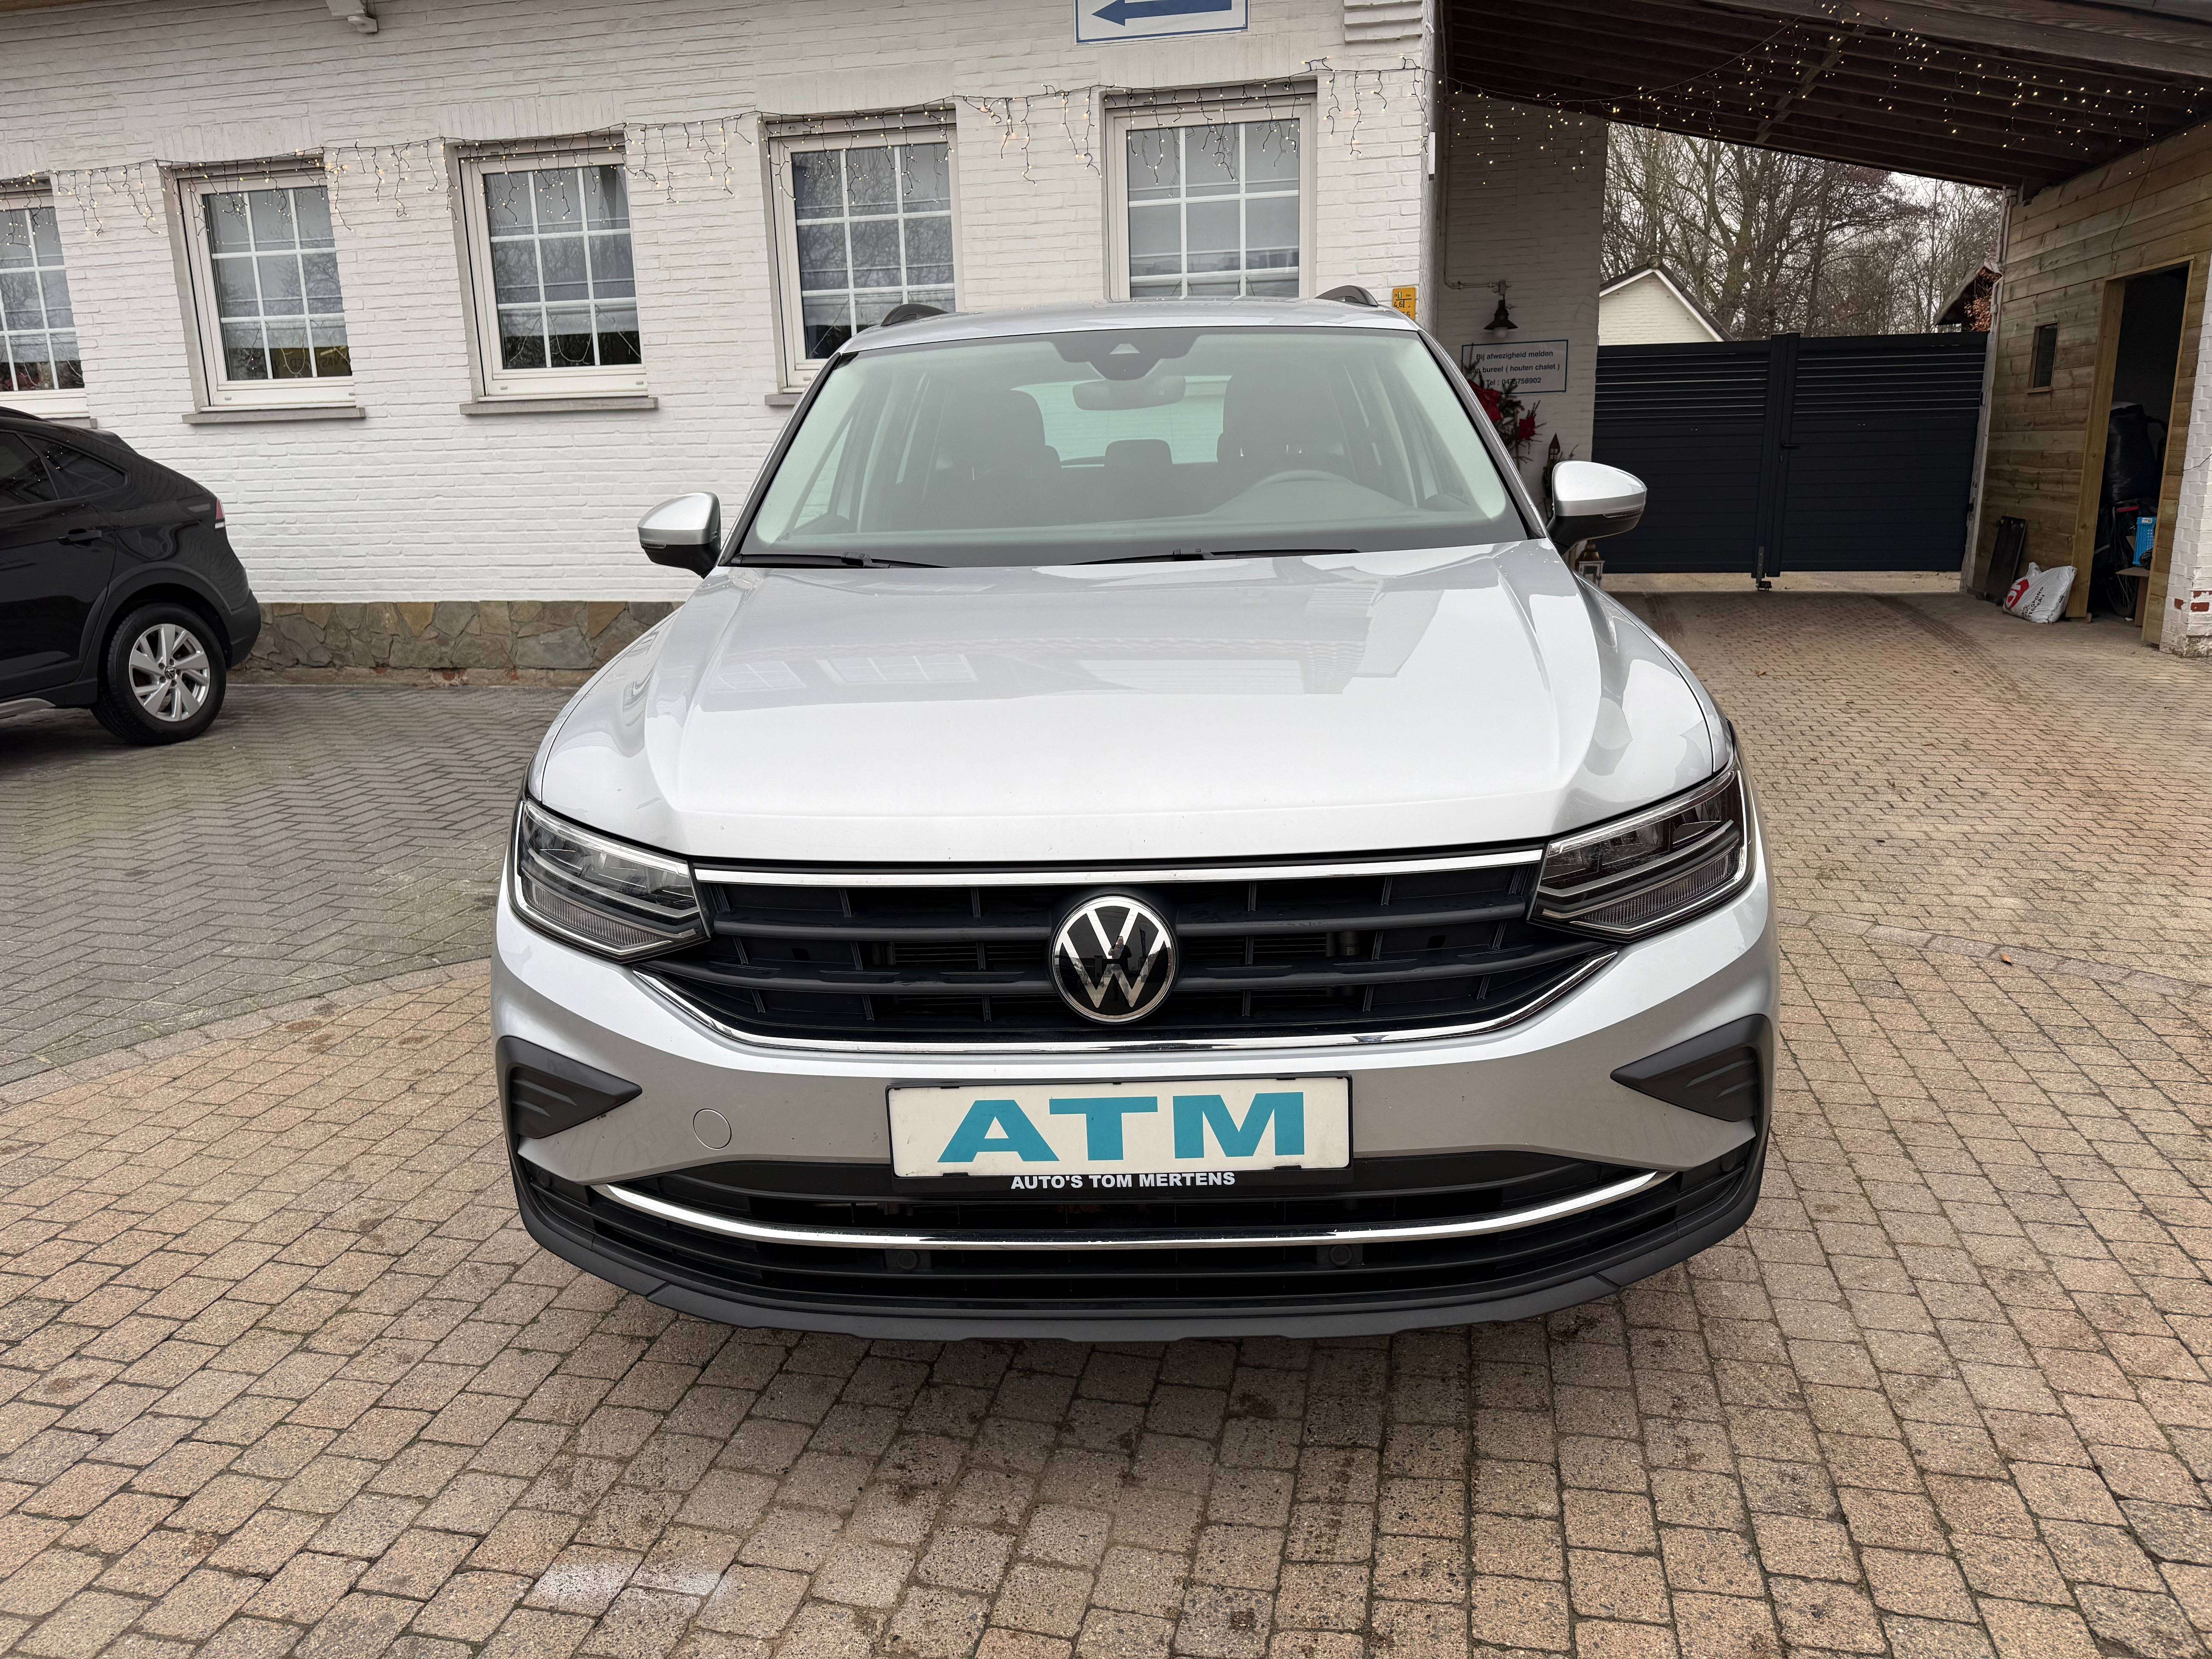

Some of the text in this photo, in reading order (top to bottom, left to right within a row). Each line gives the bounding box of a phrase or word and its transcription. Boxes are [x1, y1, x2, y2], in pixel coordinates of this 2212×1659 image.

[1487, 352, 1526, 360] afwezigheid
[937, 1091, 1305, 1162] ATM
[1011, 1171, 1236, 1189] AUTO'S TOM MERTENS
